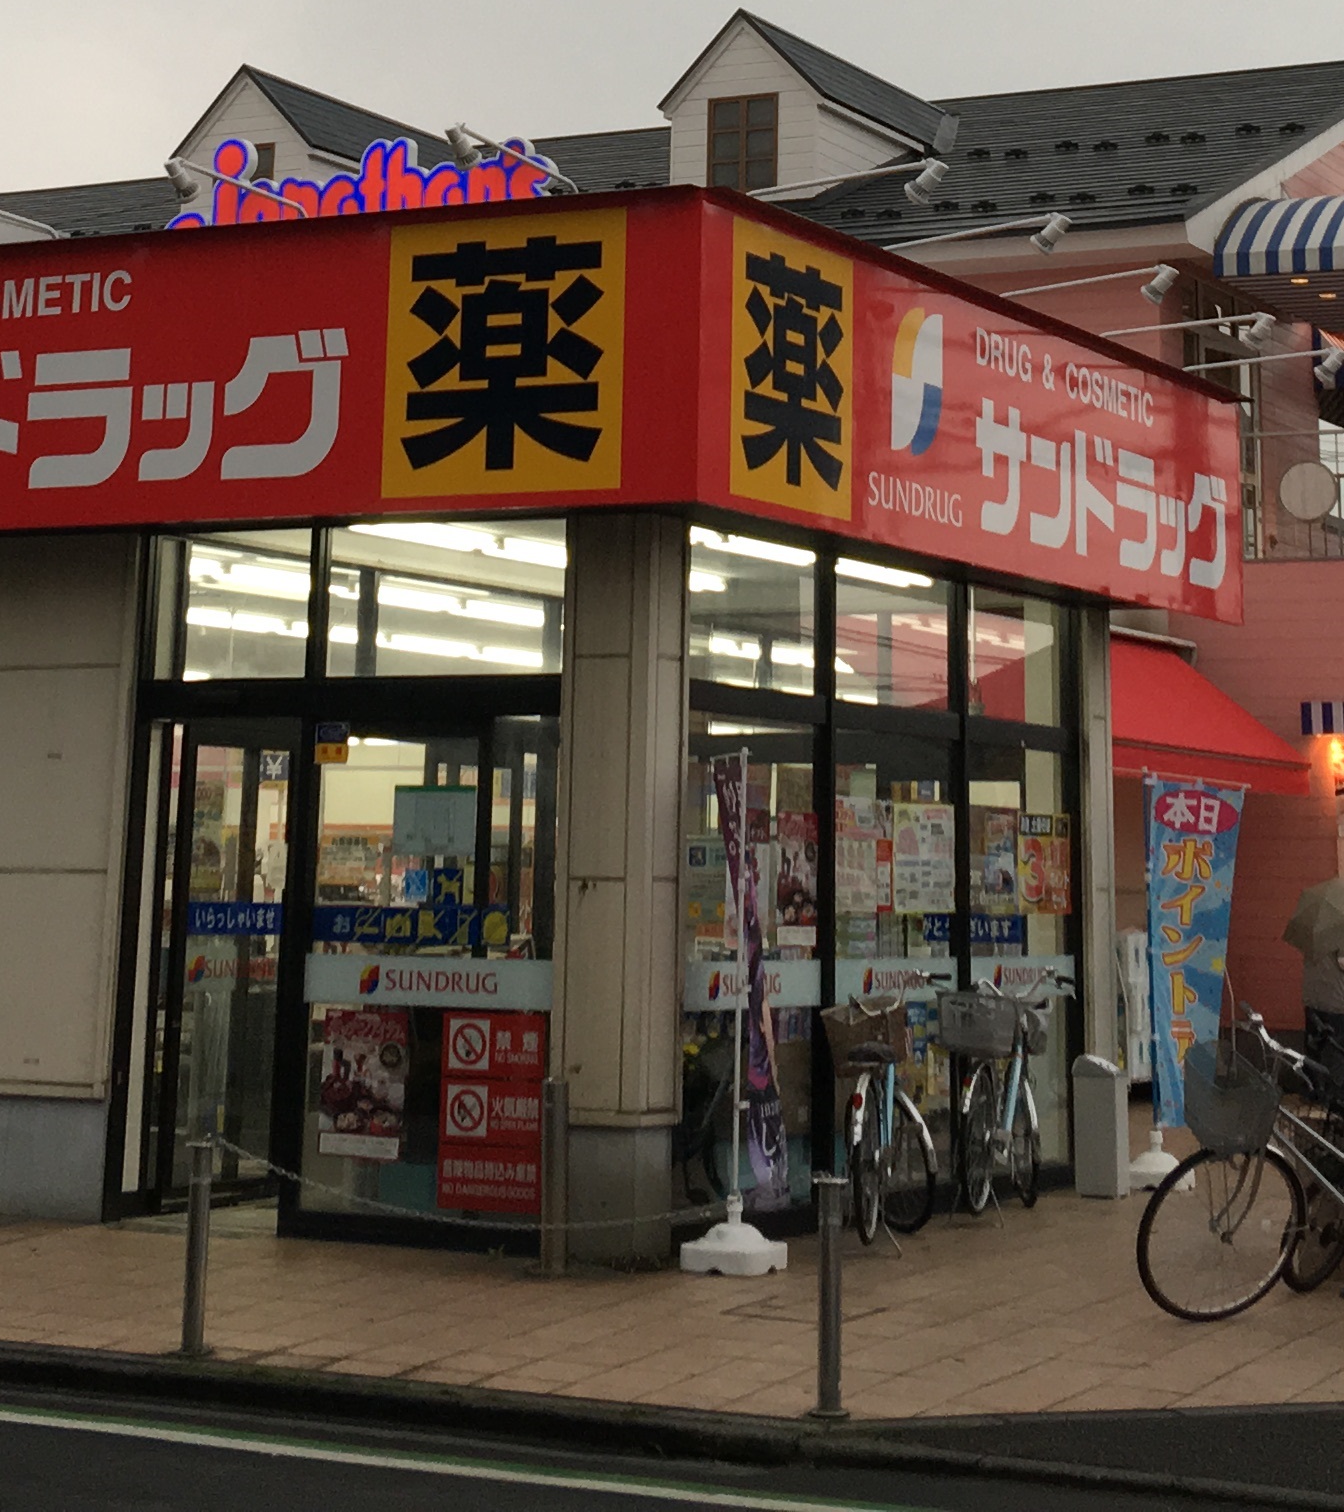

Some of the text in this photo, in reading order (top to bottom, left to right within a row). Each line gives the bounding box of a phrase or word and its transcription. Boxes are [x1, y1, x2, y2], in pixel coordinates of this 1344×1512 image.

[400, 236, 604, 471] 薬
[744, 251, 844, 491] 薬
[976, 327, 1155, 429] DRUG & COSMETIC
[867, 470, 964, 528] SUNDRUG
[976, 398, 1227, 591] サンドラッグ
[1163, 792, 1221, 833] 本日
[195, 906, 275, 929] いらっしゃいませ
[385, 968, 498, 995] SUNDRUG
[1002, 967, 1049, 985] SUNDRU
